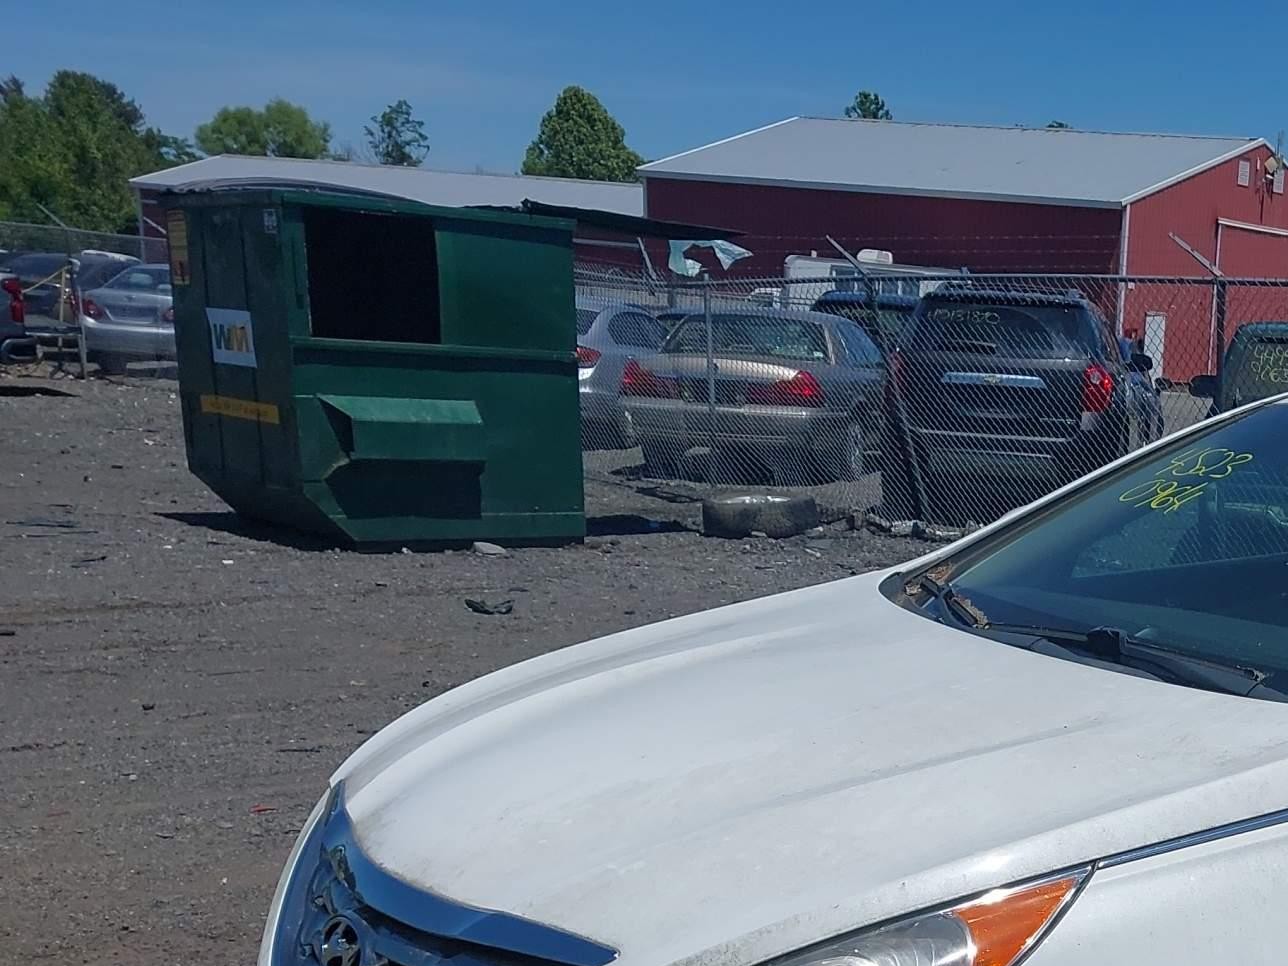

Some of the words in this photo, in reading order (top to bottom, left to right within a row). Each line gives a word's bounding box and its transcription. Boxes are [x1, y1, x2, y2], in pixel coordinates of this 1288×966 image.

[213, 322, 249, 353] WM
[1156, 448, 1253, 478] 4523
[1119, 479, 1208, 514] 0964
